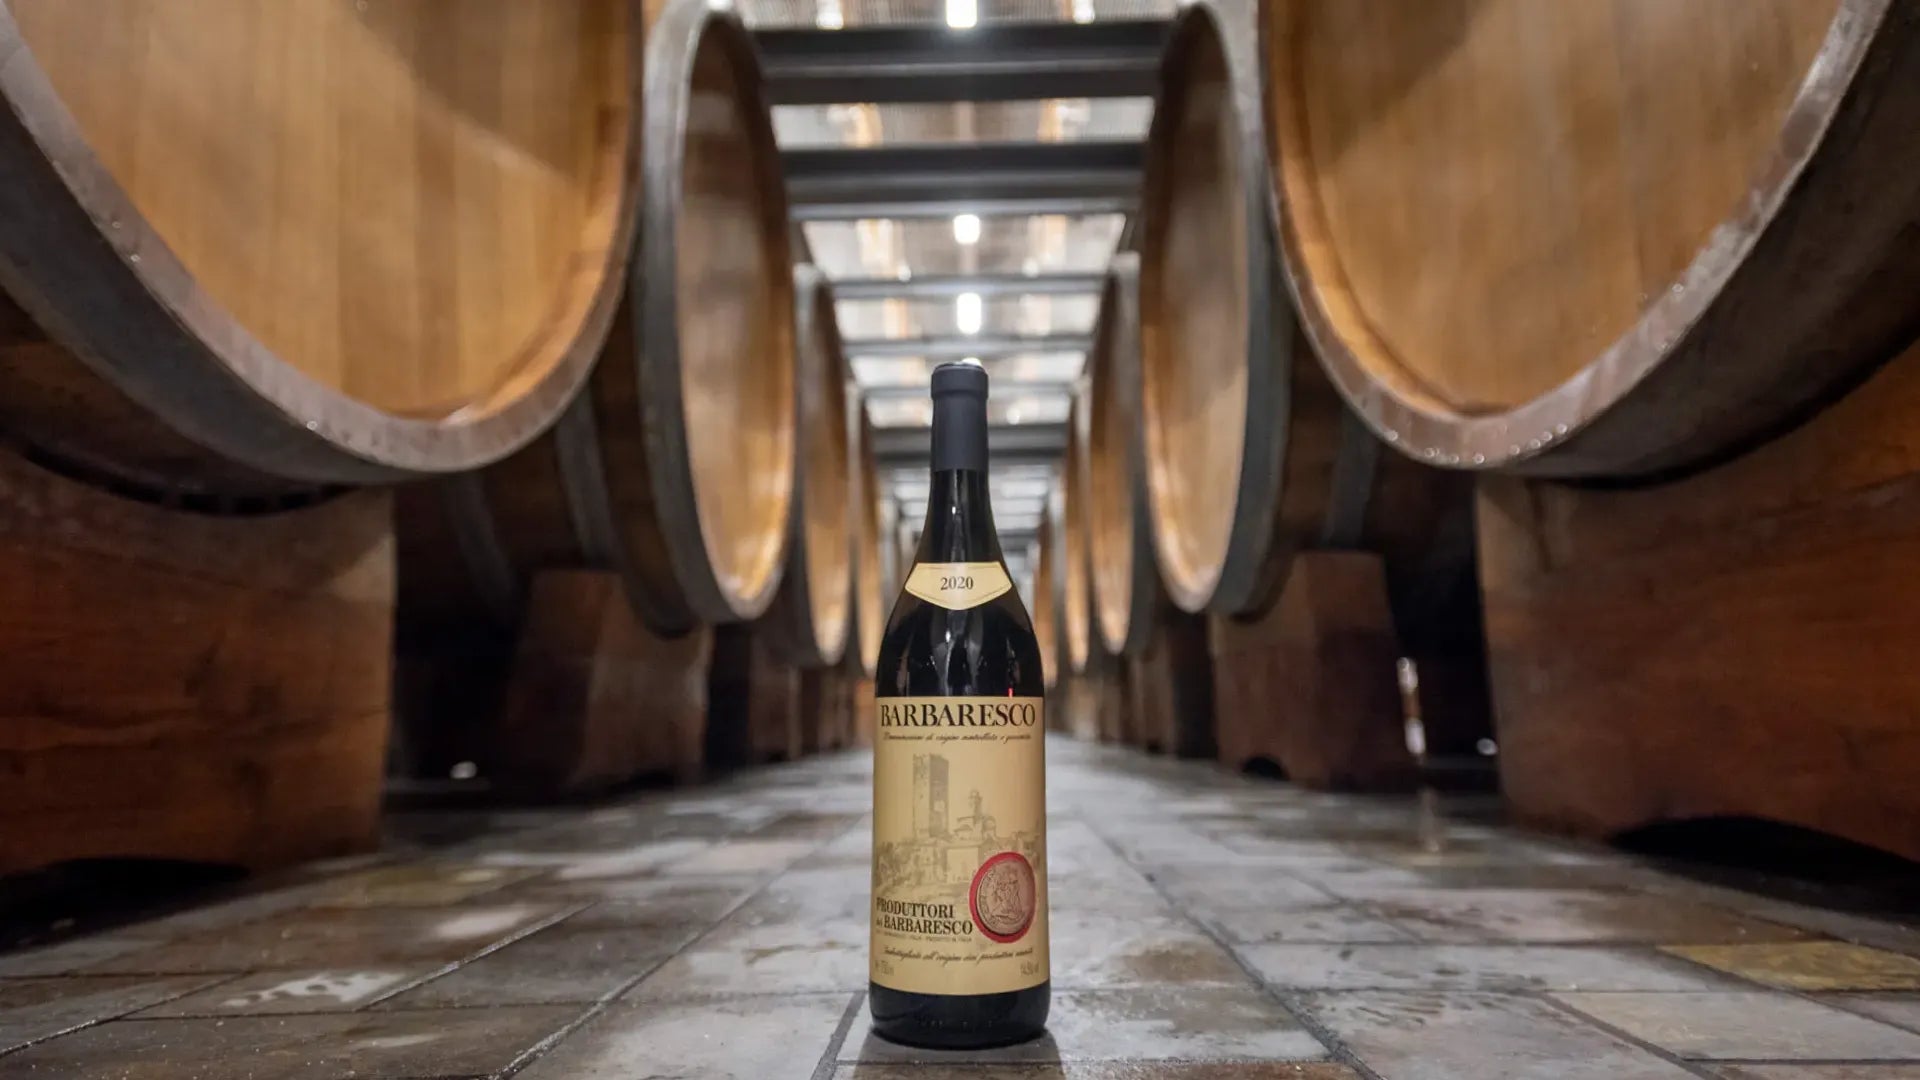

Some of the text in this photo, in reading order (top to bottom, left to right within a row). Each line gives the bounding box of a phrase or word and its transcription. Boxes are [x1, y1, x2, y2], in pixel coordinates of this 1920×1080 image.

[940, 576, 974, 591] 2020
[880, 703, 1036, 727] BARBARESCO
[876, 897, 955, 919] PRODUTTORI
[883, 914, 973, 935] BARBARESCO
